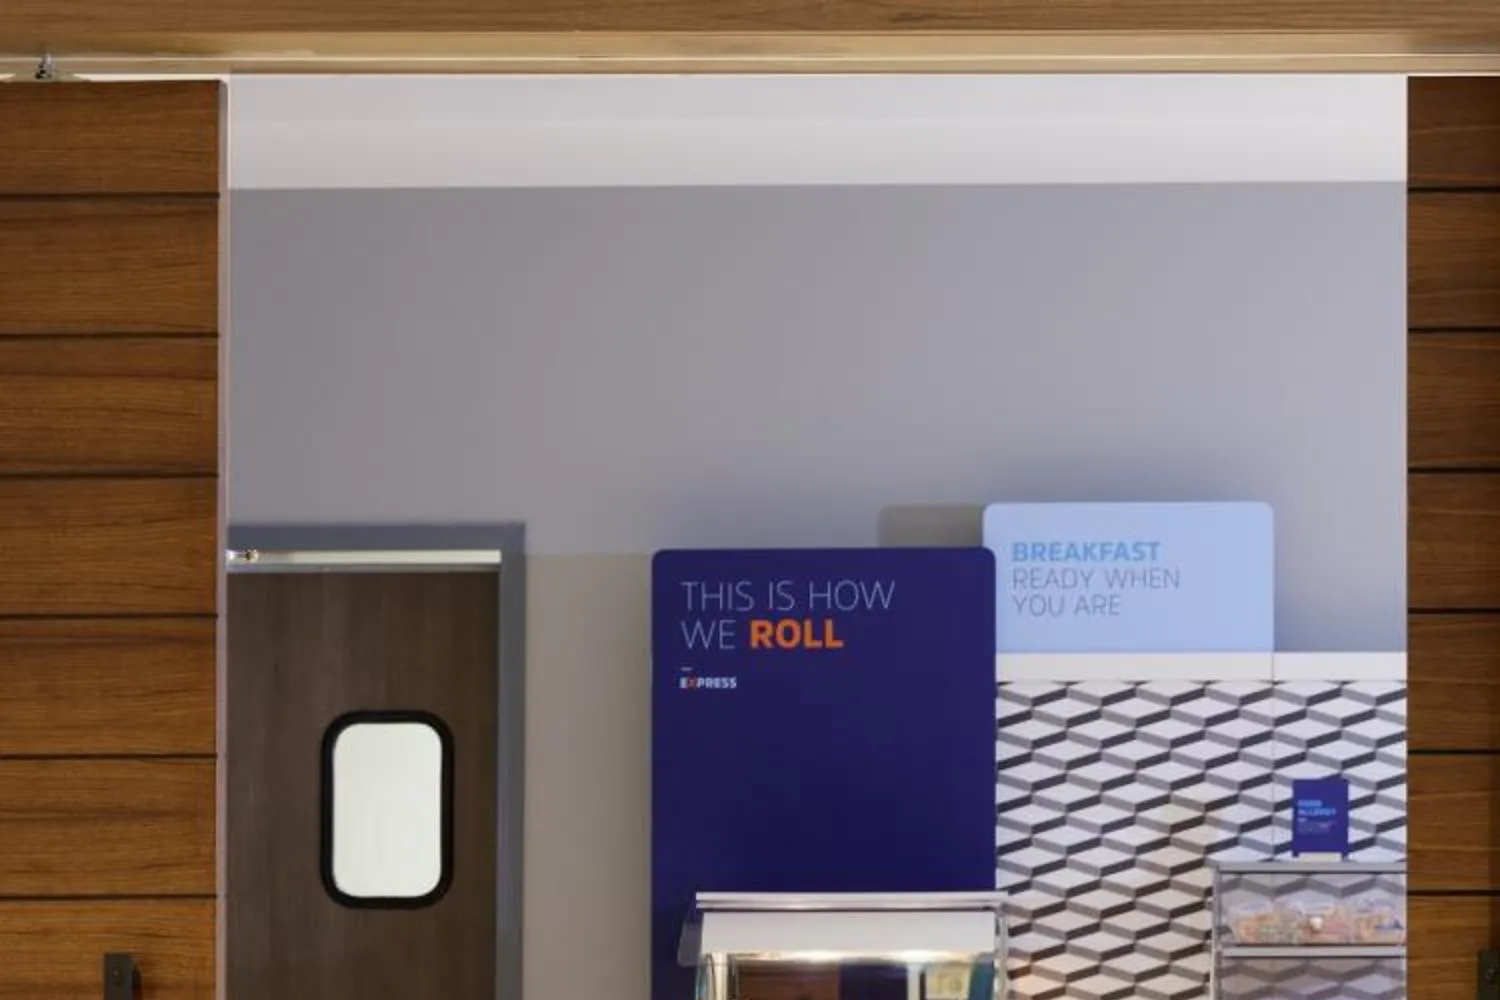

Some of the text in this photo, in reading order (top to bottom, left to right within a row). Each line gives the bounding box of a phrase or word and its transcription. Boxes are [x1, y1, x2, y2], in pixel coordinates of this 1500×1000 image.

[1012, 541, 1161, 562] BREAKFAST
[1012, 567, 1181, 590] READY WHEN
[680, 580, 896, 612] THIS IS HOW
[1012, 593, 1122, 617] YOU ARE
[680, 618, 845, 650] WE ROLL
[679, 676, 738, 690] EXPRESS
